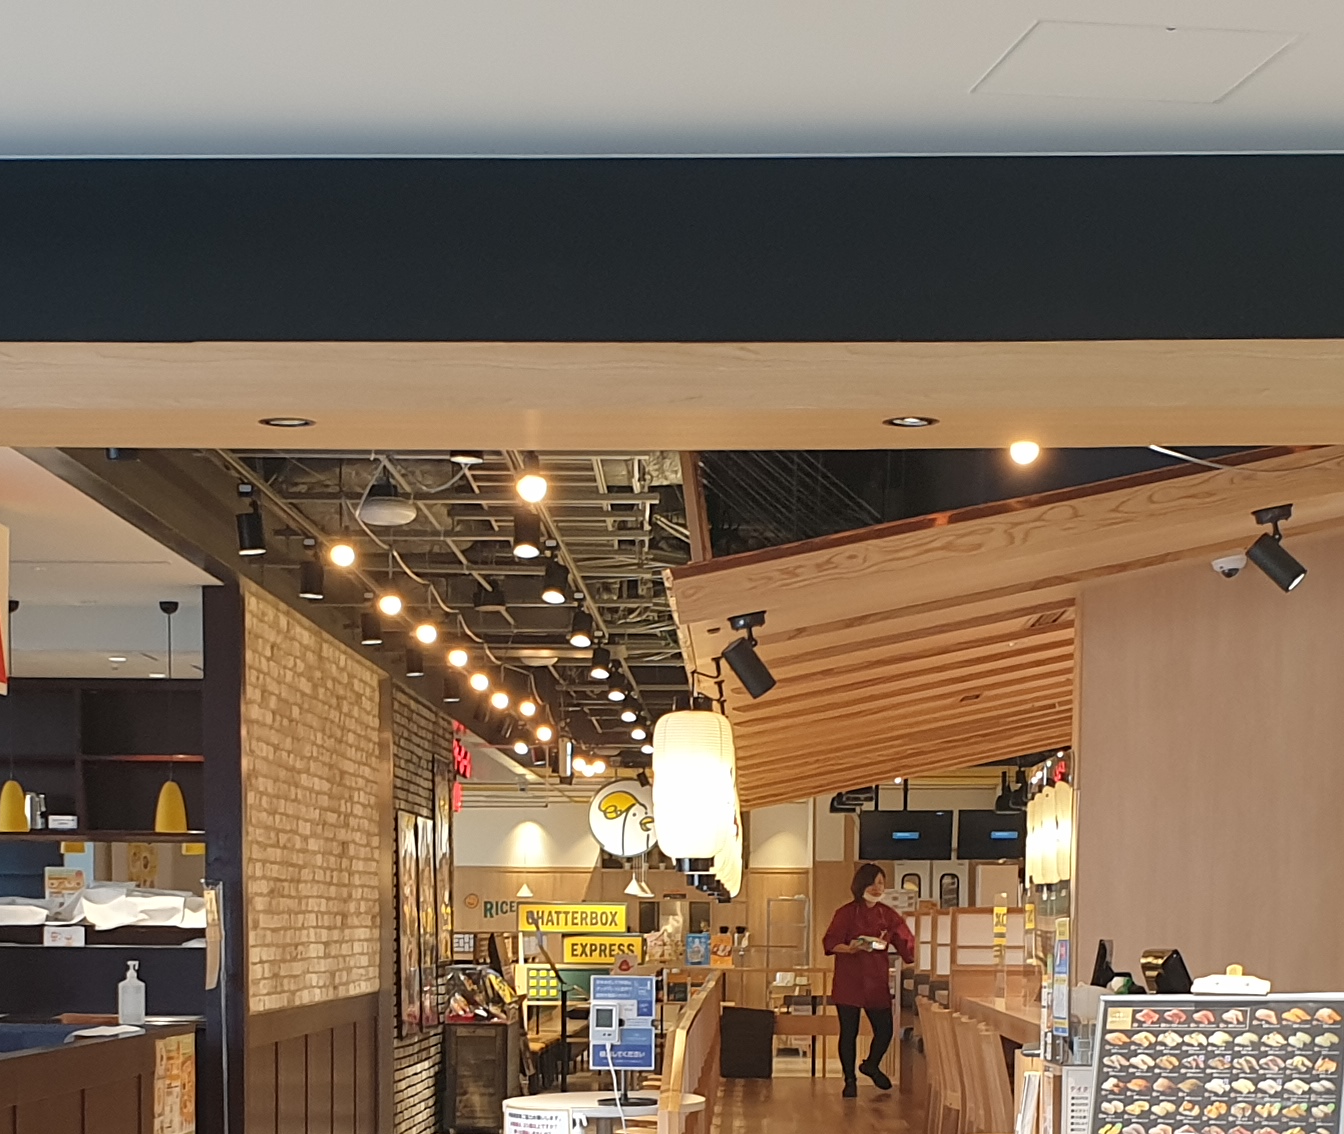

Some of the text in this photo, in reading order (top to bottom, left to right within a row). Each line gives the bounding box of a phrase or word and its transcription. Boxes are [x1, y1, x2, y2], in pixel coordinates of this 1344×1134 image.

[483, 900, 516, 919] RICE
[525, 909, 619, 927] CHATTERBOX
[570, 942, 636, 958] EXPRESS
